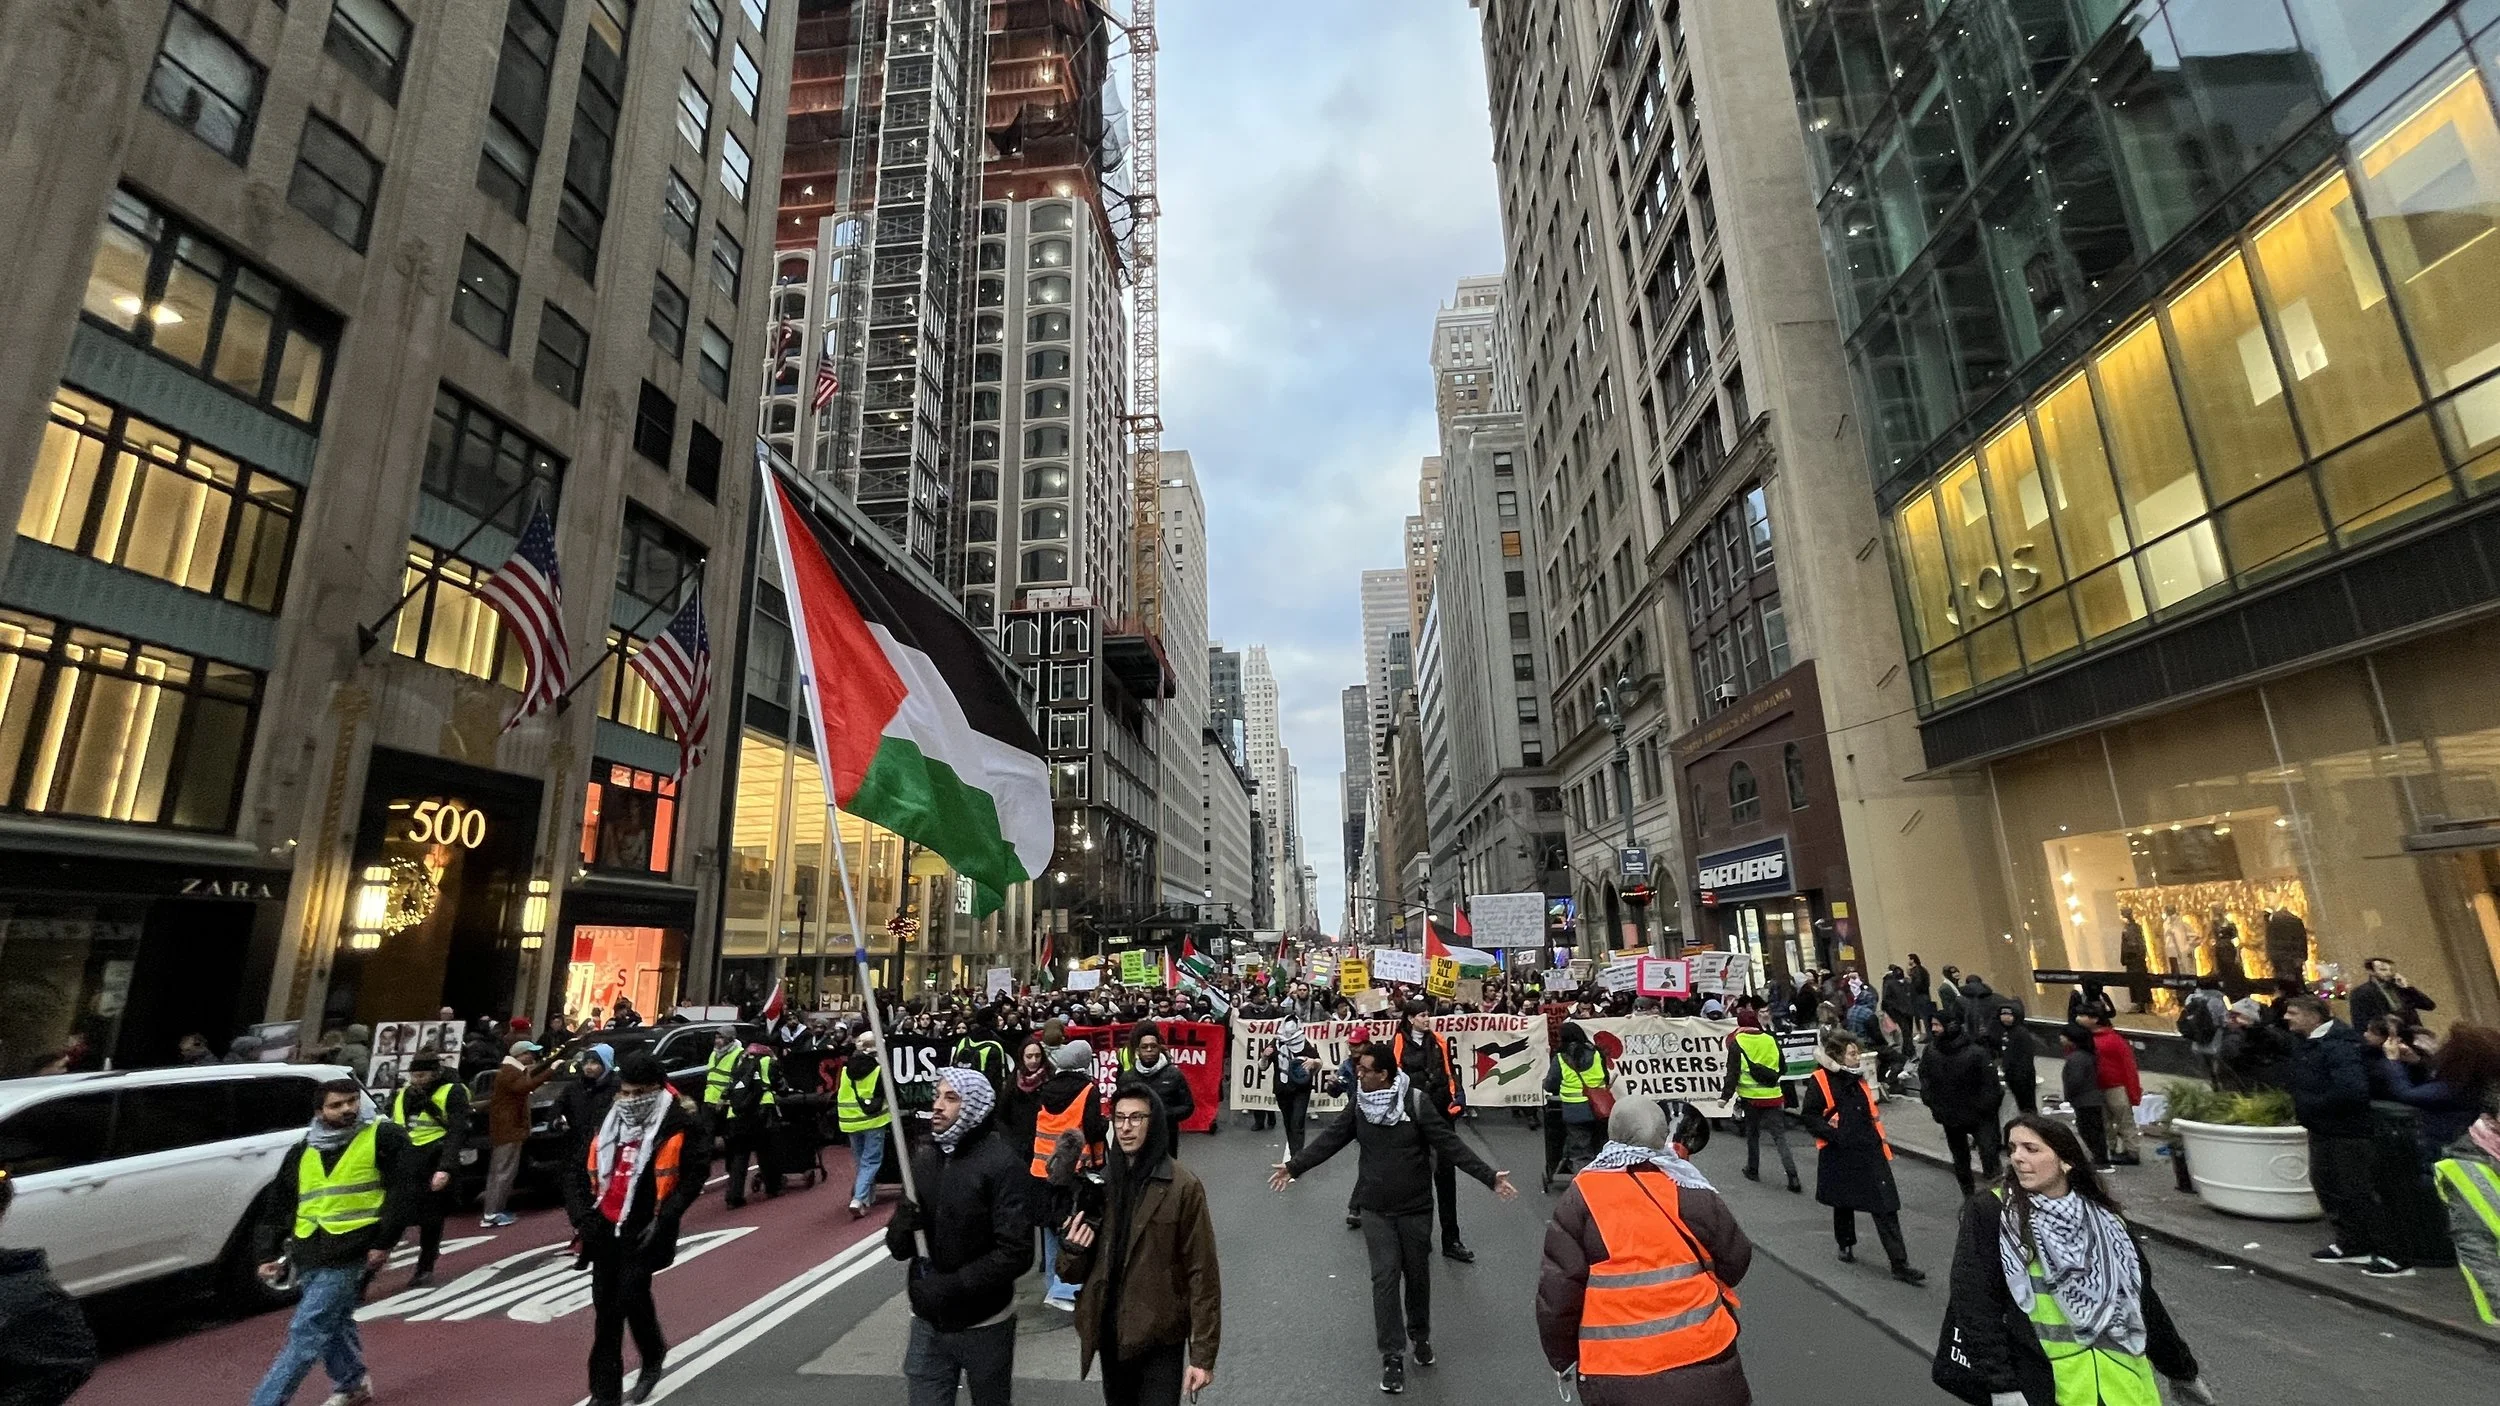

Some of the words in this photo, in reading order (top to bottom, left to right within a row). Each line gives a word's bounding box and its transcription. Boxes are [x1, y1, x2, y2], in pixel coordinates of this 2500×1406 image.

[408, 800, 486, 849] 500
[1699, 853, 1783, 889] SKECHERS
[181, 879, 272, 898] ZARA
[1437, 957, 1453, 969] END
[1376, 966, 1418, 981] PALESTINE
[1436, 967, 1449, 978] ALL
[1442, 980, 1455, 988] AID
[1435, 1016, 1529, 1032] RESISTANCE
[1624, 1032, 1678, 1055] NYC
[1681, 1036, 1724, 1053] CITY
[1616, 1056, 1718, 1076] WORKERS
[1626, 1076, 1726, 1095] PALESTIN
[1240, 1094, 1262, 1105] PARTY
[1504, 1092, 1540, 1104] @NYCPSL
